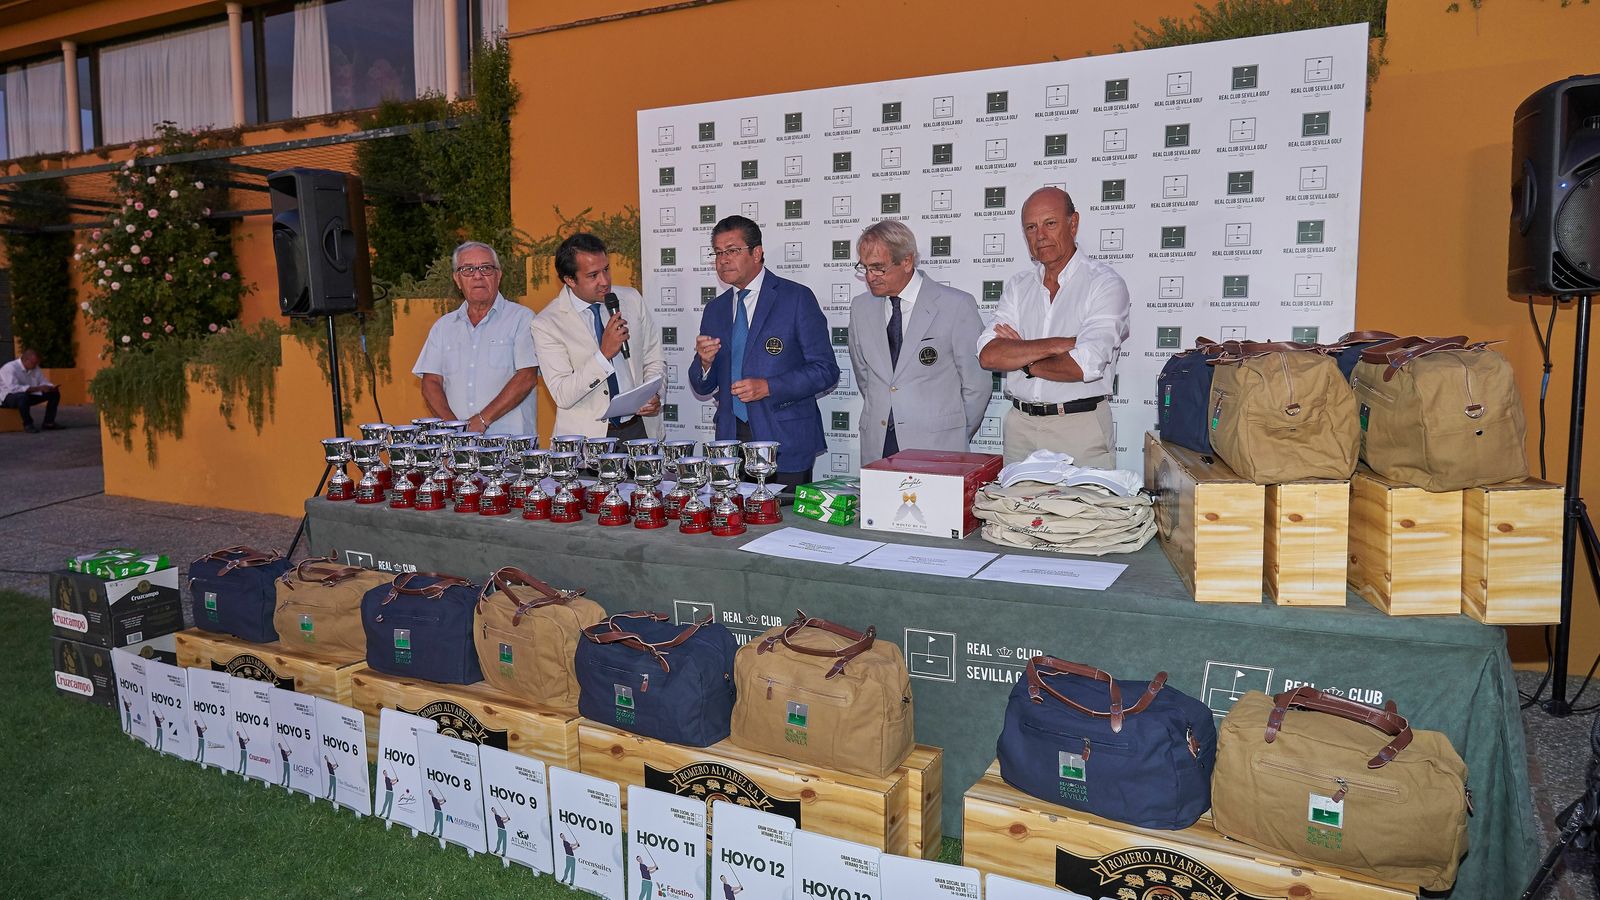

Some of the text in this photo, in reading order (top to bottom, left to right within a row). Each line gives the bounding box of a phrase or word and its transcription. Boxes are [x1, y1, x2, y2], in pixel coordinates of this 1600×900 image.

[378, 560, 418, 573] REAL CLUB
[131, 591, 159, 602] Cruzcampo
[53, 612, 86, 630] Cruzcampo
[723, 611, 782, 627] REAL CLUB
[967, 642, 992, 656] REAL
[966, 665, 1012, 683] SEVILLA
[56, 674, 92, 693] Cruzcampo
[120, 678, 138, 692] HOYO
[139, 685, 144, 695] 1
[152, 692, 182, 708] HOYO 2
[1349, 688, 1383, 705] CLUB
[194, 701, 225, 716] HOYO 3
[420, 704, 442, 718] ROMERO
[444, 705, 469, 722] ALVAREZ
[236, 711, 269, 727] HOYO 4
[277, 723, 310, 740] HOYO 5
[323, 734, 358, 756] HOYO 6
[384, 748, 415, 766] HOYO
[293, 764, 314, 776] LIGIER
[679, 766, 710, 782] ROMERO
[711, 767, 748, 789] ALVAREZ
[427, 768, 472, 791] HOYO 8
[490, 785, 537, 809] HOYO 9
[1060, 791, 1088, 802] SEVILLA
[559, 809, 613, 836] HOYO 10
[637, 830, 695, 858] HOYO 11
[722, 848, 785, 878] HOYO 12
[1107, 851, 1223, 896] ROMERO ALVAREZ S.A.
[667, 885, 694, 898] Faustino
[803, 878, 851, 900] HOYO
